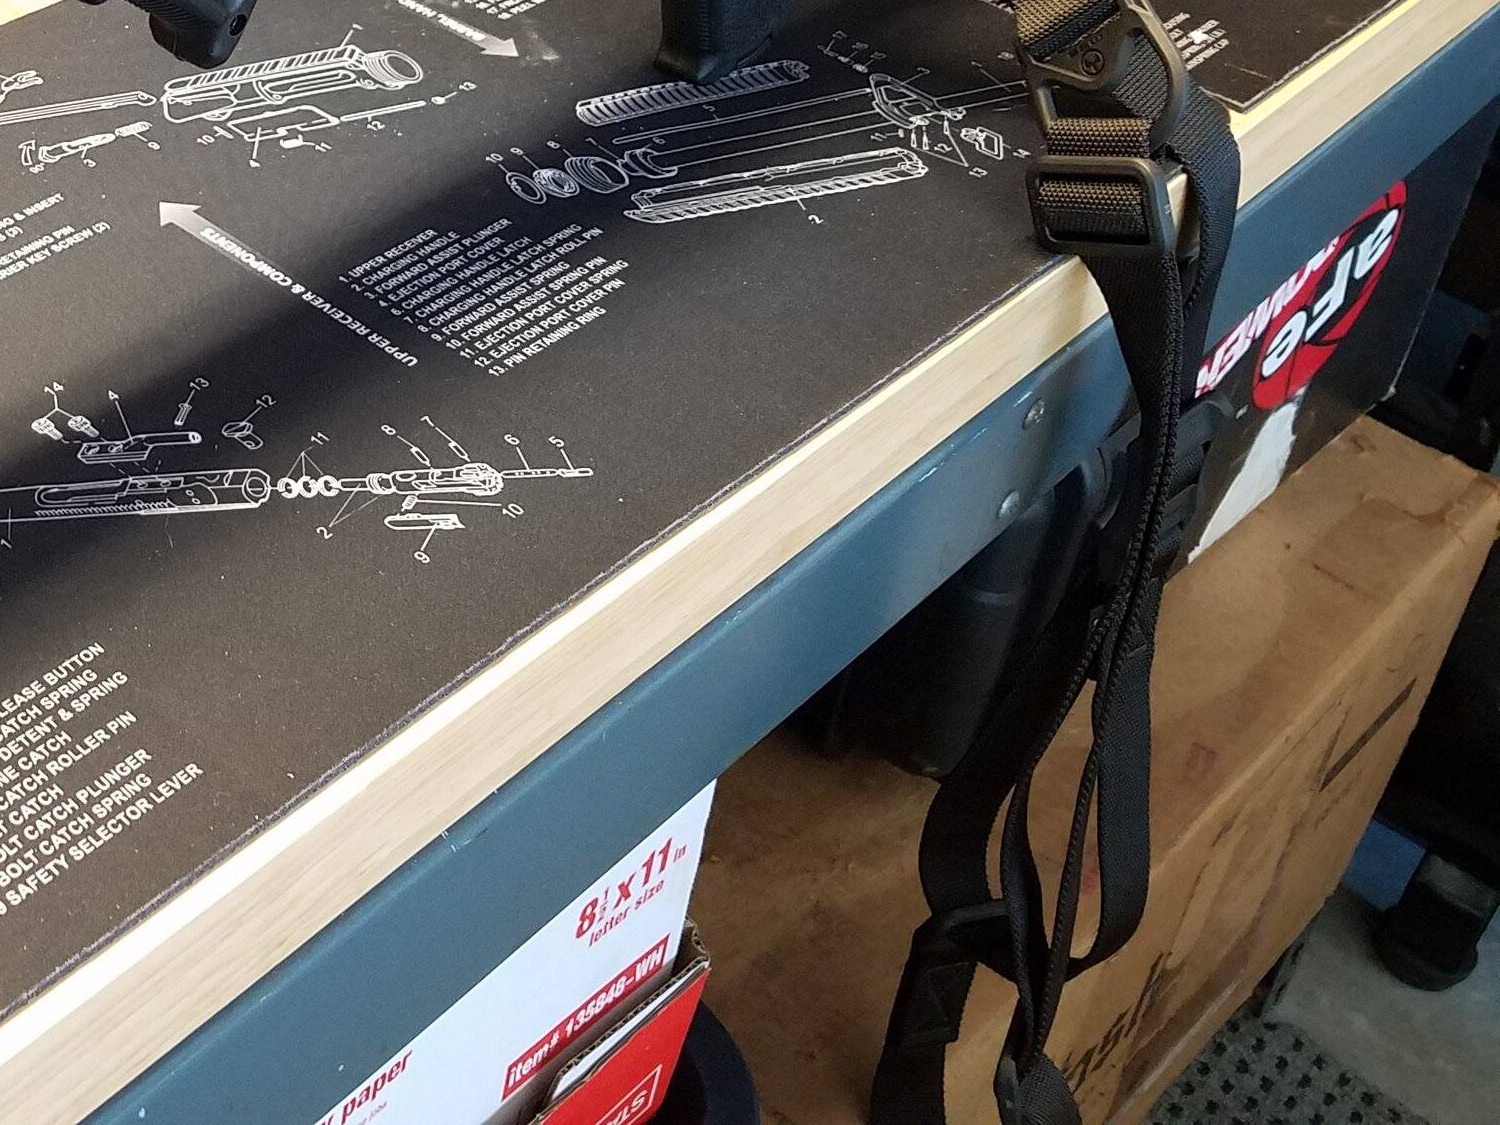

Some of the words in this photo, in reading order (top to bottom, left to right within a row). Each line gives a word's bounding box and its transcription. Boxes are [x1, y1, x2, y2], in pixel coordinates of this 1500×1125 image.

[200, 227, 293, 287] COMPONENTS
[348, 255, 388, 278] UPPER
[383, 229, 438, 259] RECEIVER
[374, 262, 429, 294] FORWARD
[426, 243, 464, 267] ASSIST
[461, 218, 512, 247] PLUNGER
[428, 293, 486, 326] CHARGING
[481, 269, 528, 296] HANDLE
[523, 251, 560, 273] LATCH
[555, 238, 588, 255] ROLL
[581, 227, 604, 240] PIN
[291, 282, 307, 295] &
[302, 290, 373, 336] RECEIVER
[367, 331, 419, 368] UPPER
[43, 381, 64, 397] 14
[189, 377, 210, 398] 13
[254, 395, 277, 414] 12
[502, 503, 525, 519] 10
[42, 642, 105, 686] BUTTON
[45, 728, 111, 777] ROLLER
[106, 710, 137, 735] PIN
[5, 853, 69, 906] SAFETY
[68, 797, 154, 861] SELECTOR
[149, 763, 204, 804] LEVER
[640, 837, 673, 889] 11
[588, 902, 634, 947] letter
[634, 879, 664, 912] size
[341, 1049, 412, 1124] paper
